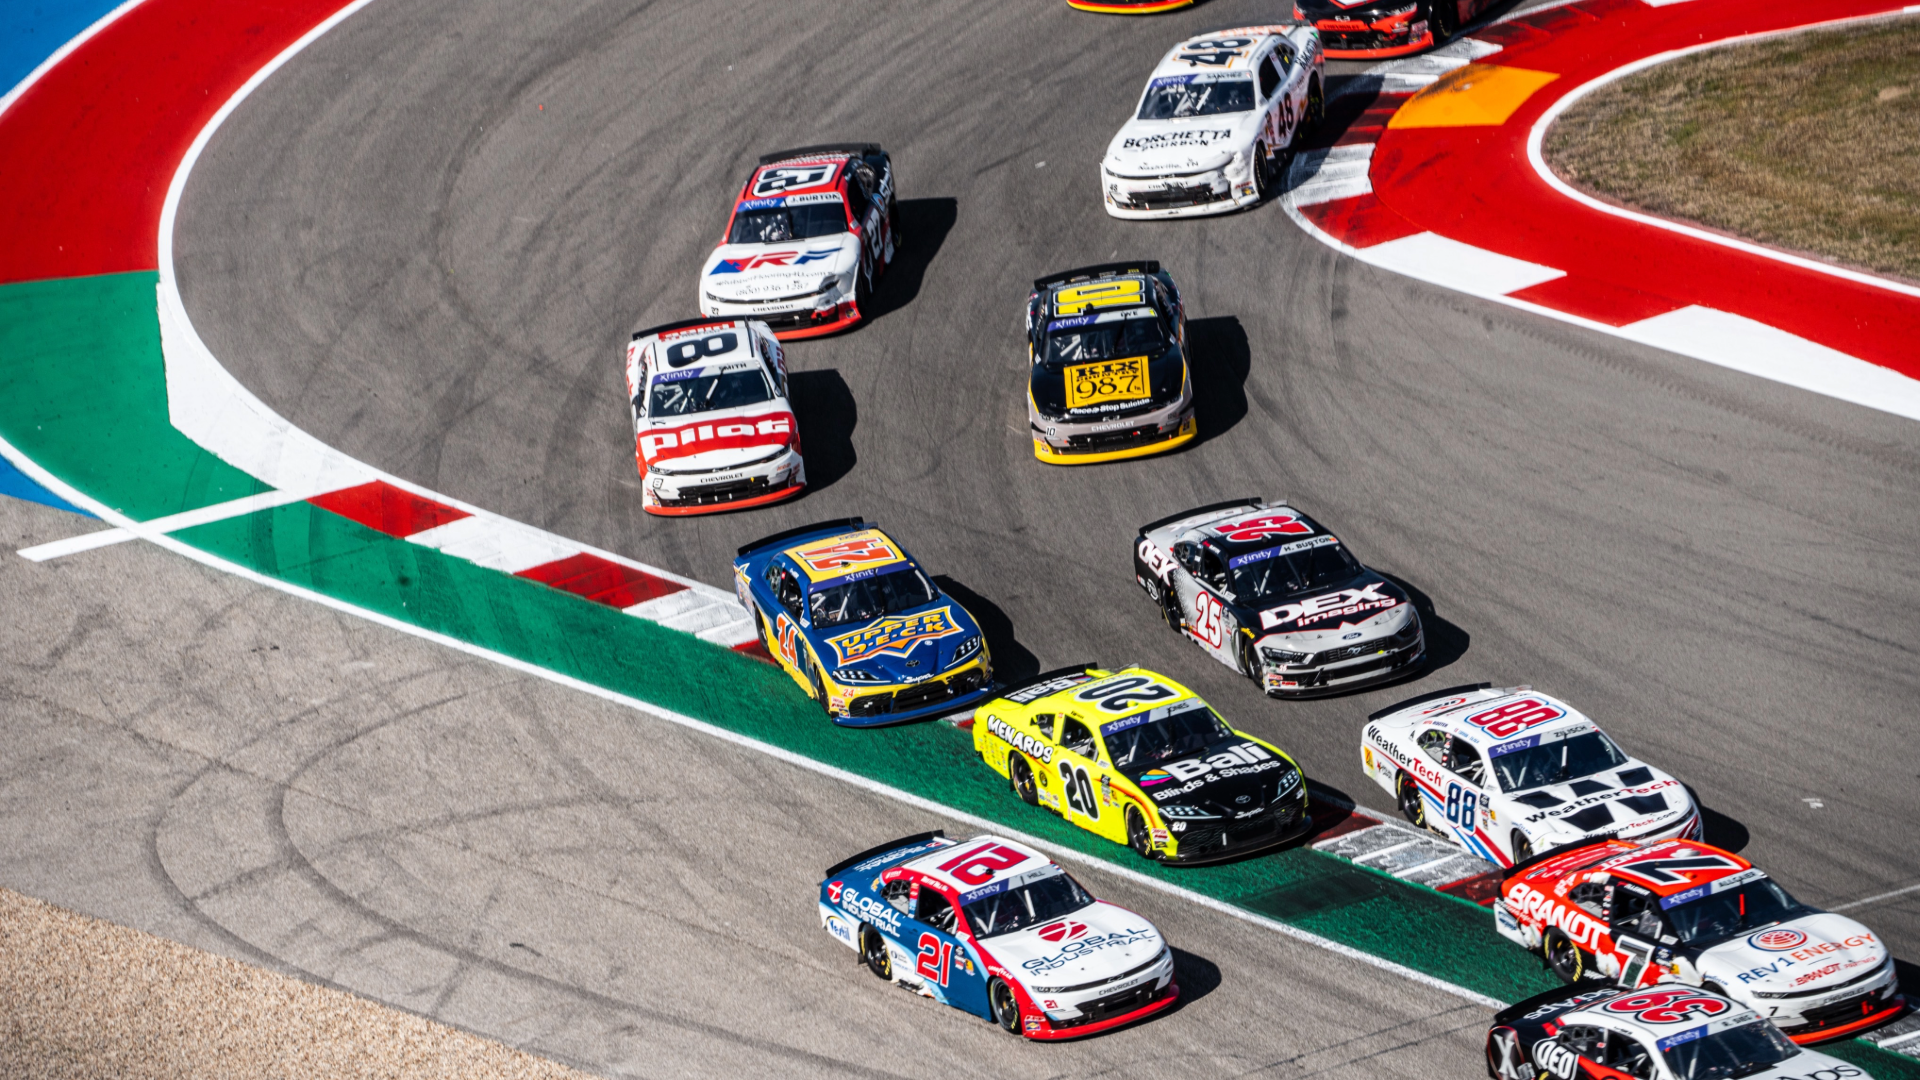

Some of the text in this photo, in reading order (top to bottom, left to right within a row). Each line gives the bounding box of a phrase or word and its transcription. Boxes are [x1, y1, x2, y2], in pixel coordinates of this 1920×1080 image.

[1173, 38, 1258, 69] 48
[1156, 75, 1188, 87] xfinity
[1206, 71, 1242, 80] SANCHEZ
[1277, 91, 1294, 138] 48
[1123, 128, 1232, 149] BORCHETTA
[1141, 138, 1210, 153] BOURBON
[1186, 160, 1200, 168] TN
[753, 163, 838, 198] 27
[1109, 184, 1118, 192] 48
[744, 198, 778, 210] xfinity
[799, 193, 840, 202] BURTON
[866, 207, 883, 260] 27
[1053, 279, 1146, 318] 10
[752, 303, 794, 313] CHEVROLET
[1055, 316, 1089, 329] xfinity
[667, 332, 738, 369] 8
[719, 362, 747, 371] SMITH
[1076, 360, 1139, 378] KIX
[659, 370, 694, 382] xfinity
[1076, 370, 1137, 382] COUNTRY
[1076, 375, 1139, 400] 98.7
[1099, 403, 1120, 413] Stop
[1119, 398, 1150, 410] Suicide
[1046, 426, 1056, 437] 10
[1091, 420, 1135, 433] CHEVROLET
[652, 478, 663, 489] 8
[700, 472, 743, 484] CHEVROLET
[1210, 515, 1315, 543] 25
[1296, 536, 1332, 549] BURTON
[797, 537, 897, 572] 24
[1138, 539, 1180, 587] DEX
[1237, 550, 1272, 565] xfinity
[845, 568, 879, 582] xfinity
[1258, 581, 1391, 631] DEX
[1296, 597, 1397, 628] imaging
[1195, 590, 1224, 650] 25
[842, 614, 941, 648] UPPER
[1345, 632, 1361, 640] Ford
[776, 612, 800, 672] 24
[903, 673, 934, 684] Supra
[843, 688, 854, 698] 24
[1074, 676, 1182, 714] 20
[1166, 701, 1190, 714] JONES
[1106, 714, 1142, 732] xfinity
[1464, 696, 1567, 741] 88
[988, 714, 1054, 764] MENARDS
[1553, 724, 1588, 739] ZILISCH
[1496, 738, 1531, 755] xfinity
[1161, 741, 1272, 783] Bali
[1367, 724, 1442, 788] WeatherTech
[1152, 759, 1281, 801] Blinds & Shades
[1059, 759, 1100, 823] 20
[1445, 779, 1479, 834] 88
[1525, 779, 1680, 824] WeatherTech
[1234, 807, 1266, 820] Supra
[1172, 821, 1187, 832] 20
[1583, 810, 1679, 841] WeatherTech.com
[936, 841, 1031, 886] 21
[1601, 840, 1682, 872] BRANDT
[1027, 870, 1046, 880] HILL
[1612, 855, 1744, 887] 7
[1717, 871, 1756, 889] ALLGAIER
[965, 883, 1001, 901] xfinity
[1667, 888, 1704, 905] xfinity
[842, 887, 902, 928] GLOBAL
[1504, 882, 1612, 951] BRANDT
[841, 899, 901, 938] INDUSTRIAL
[1022, 928, 1149, 970] GLOBAL
[1029, 933, 1156, 977] INDUSTRIAL
[1790, 932, 1877, 962] ENERGY
[915, 931, 954, 989] 21
[1614, 934, 1656, 990] 7
[988, 965, 1014, 981] GOODYEAR
[1795, 962, 1841, 987] BRANDT
[1843, 956, 1878, 969] PARTNER
[1098, 978, 1139, 996] CHEVROLET
[1823, 986, 1865, 1003] CHEVROLET
[1044, 1000, 1059, 1009] 21
[1602, 988, 1732, 1026] 39
[1769, 1006, 1779, 1017] 7
[1734, 1015, 1753, 1025] SIEG
[1664, 1030, 1700, 1047] xfinity
